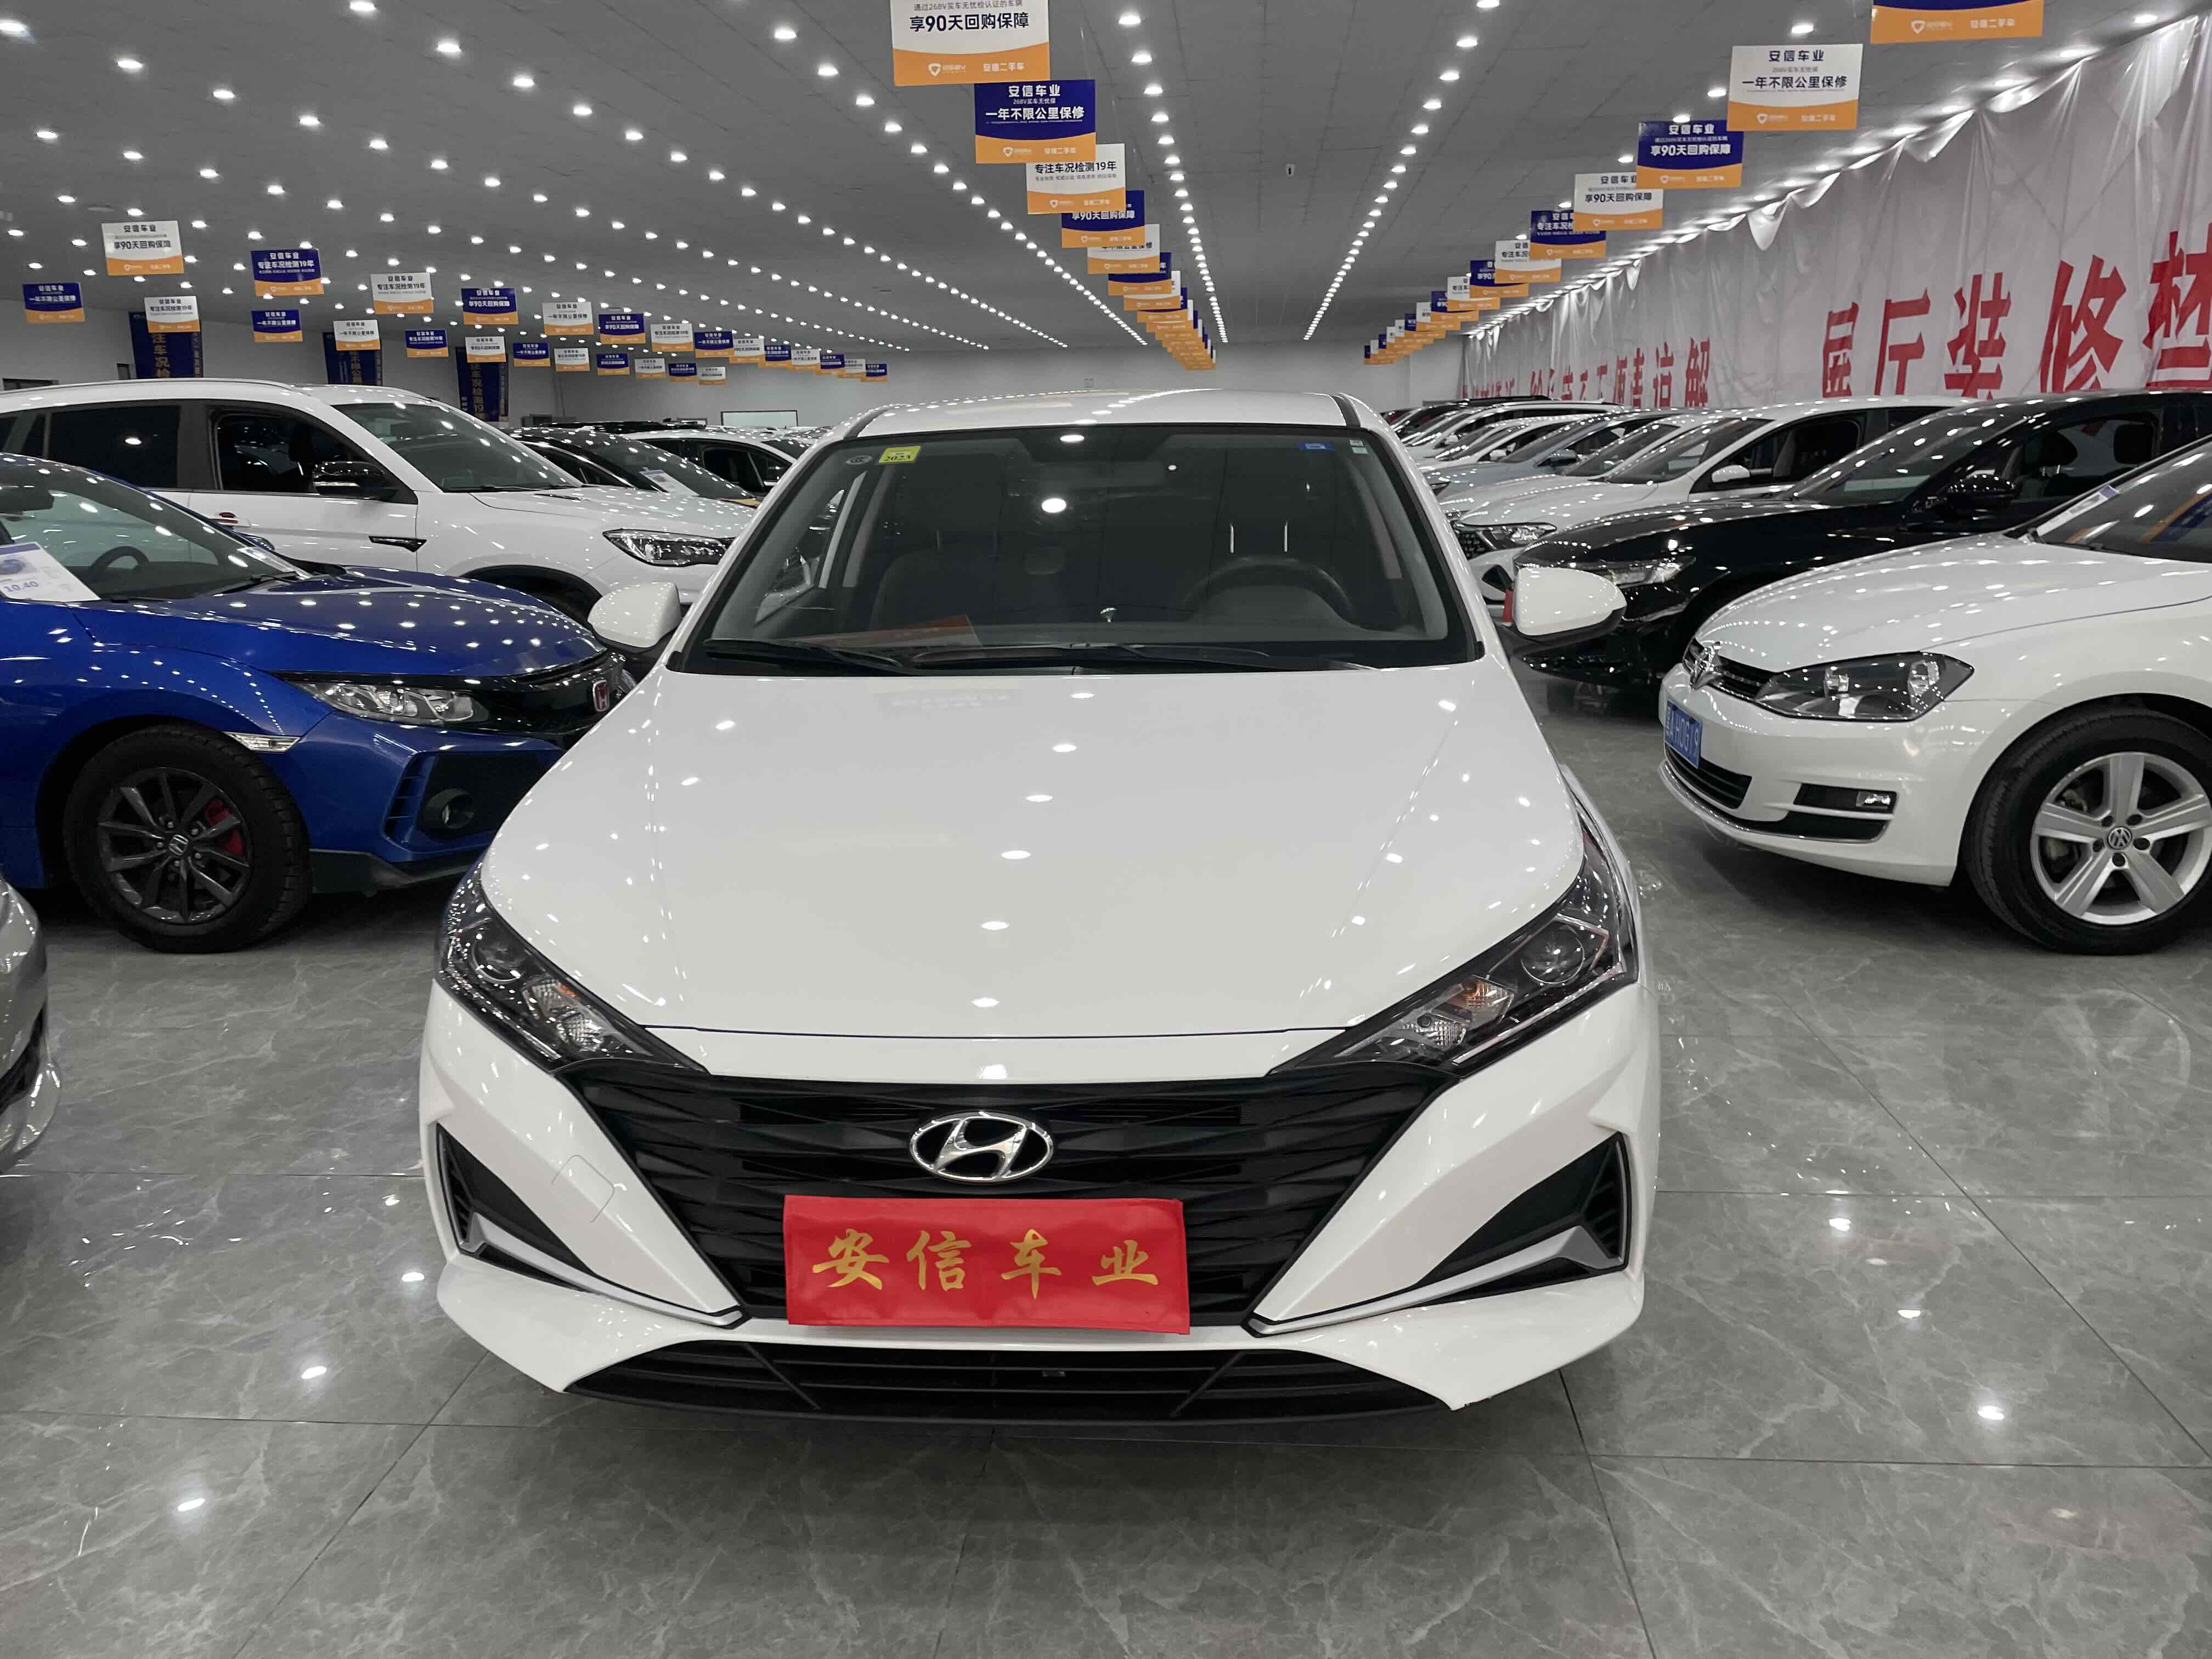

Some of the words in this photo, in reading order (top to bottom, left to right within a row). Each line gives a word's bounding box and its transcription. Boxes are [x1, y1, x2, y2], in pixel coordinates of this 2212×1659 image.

[910, 12, 1029, 32] 享90天回购保障
[1769, 49, 1824, 62] 安信车业
[1742, 75, 1847, 89] 一年不限公里保修
[1008, 84, 1060, 97] 安信车业
[986, 106, 1084, 120] 一年不限公里保修
[1669, 123, 1714, 135] 安信车业
[1650, 144, 1731, 156] 享90天回购保障
[1035, 161, 1117, 174] 专注车况检测19年
[1585, 193, 1652, 202] 享90天回购保障
[812, 1228, 1159, 1300] 安信车业
